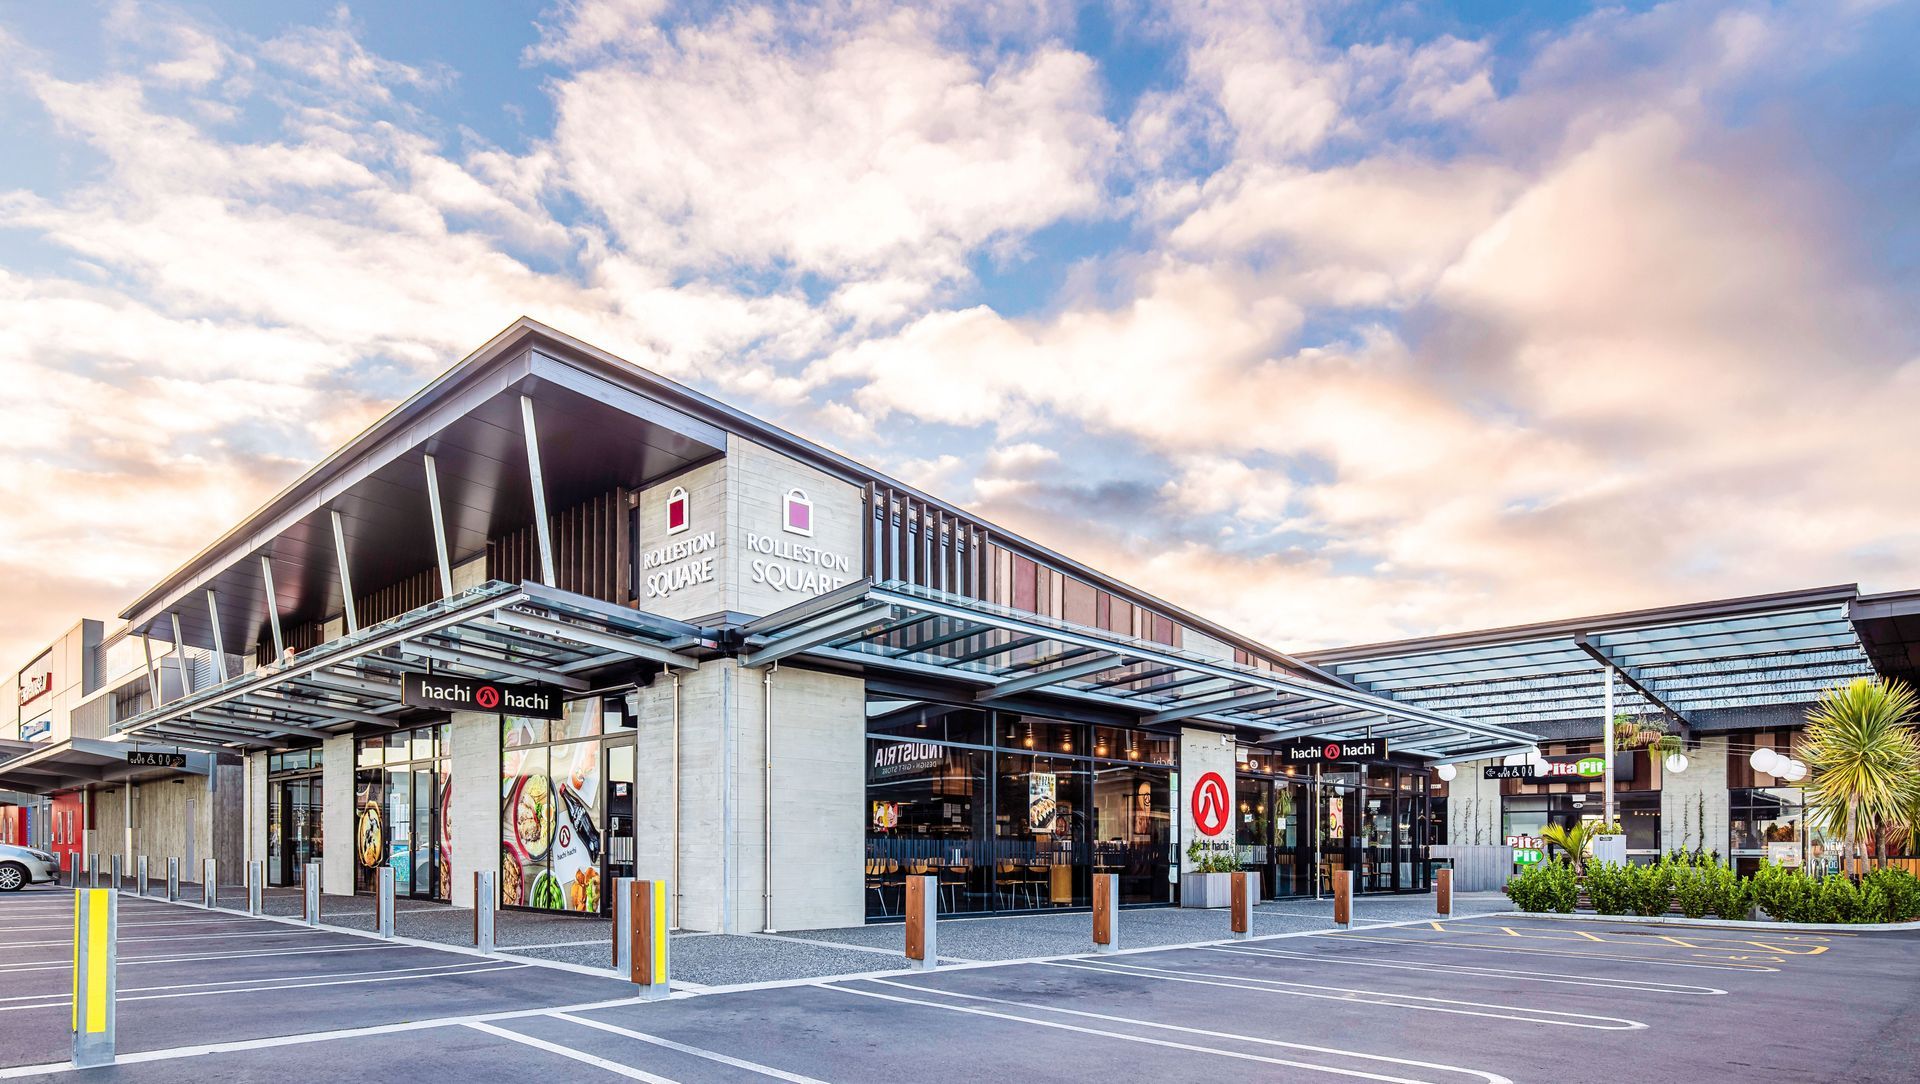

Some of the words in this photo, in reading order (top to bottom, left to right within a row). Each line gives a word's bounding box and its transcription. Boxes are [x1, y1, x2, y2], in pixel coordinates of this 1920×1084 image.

[643, 531, 716, 570] ROLLESTON
[747, 532, 849, 573] ROLLESTON
[646, 556, 714, 598] SQUARE
[421, 680, 471, 702] hachi
[504, 690, 549, 710] hachi
[1291, 745, 1321, 759] hachi
[1342, 743, 1375, 756] hachi
[1579, 761, 1604, 774] Pit
[1505, 835, 1544, 849] Pita
[1512, 848, 1539, 862] Pit
